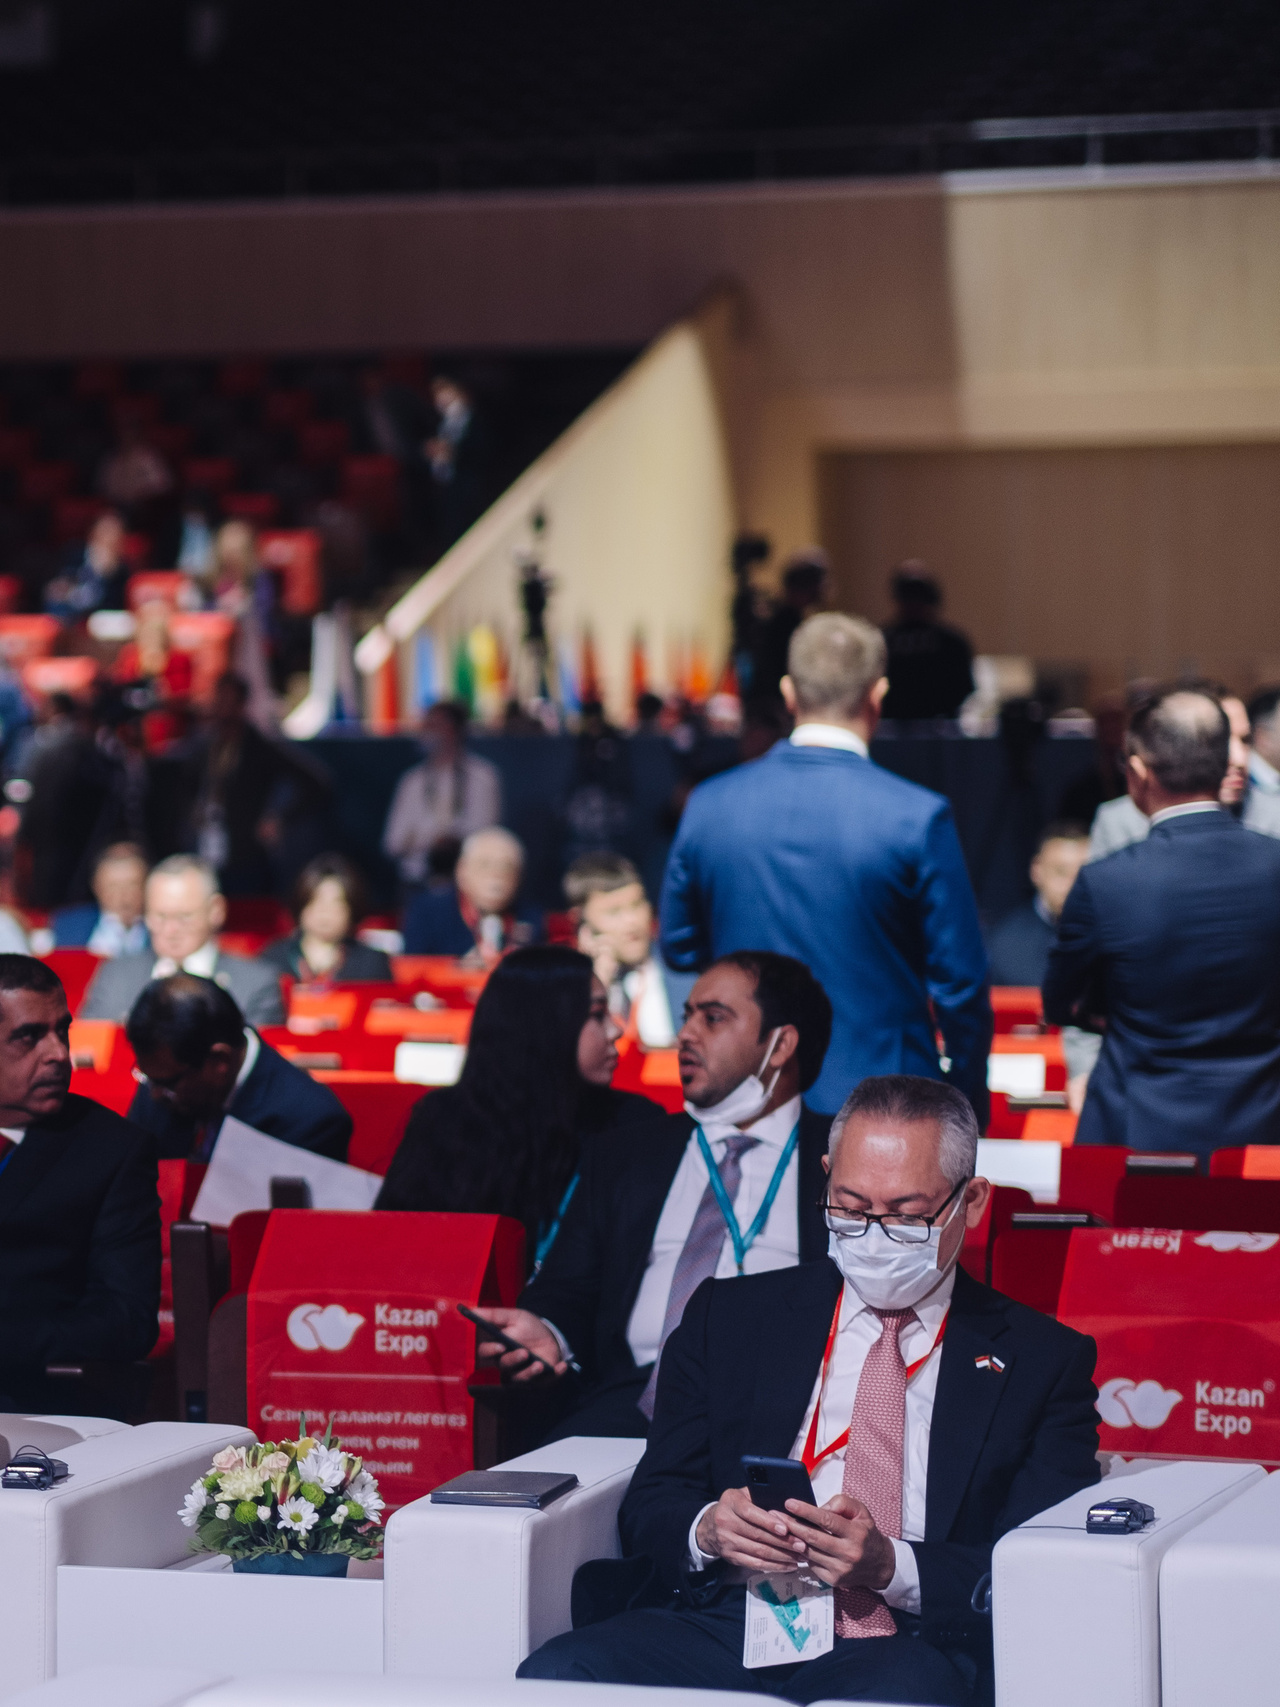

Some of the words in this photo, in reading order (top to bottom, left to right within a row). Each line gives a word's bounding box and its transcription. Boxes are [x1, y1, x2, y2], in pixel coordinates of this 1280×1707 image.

[374, 1303, 438, 1327] Kazan
[374, 1330, 428, 1357] Expo
[1195, 1380, 1265, 1407] Kazan
[1194, 1408, 1252, 1439] Expo
